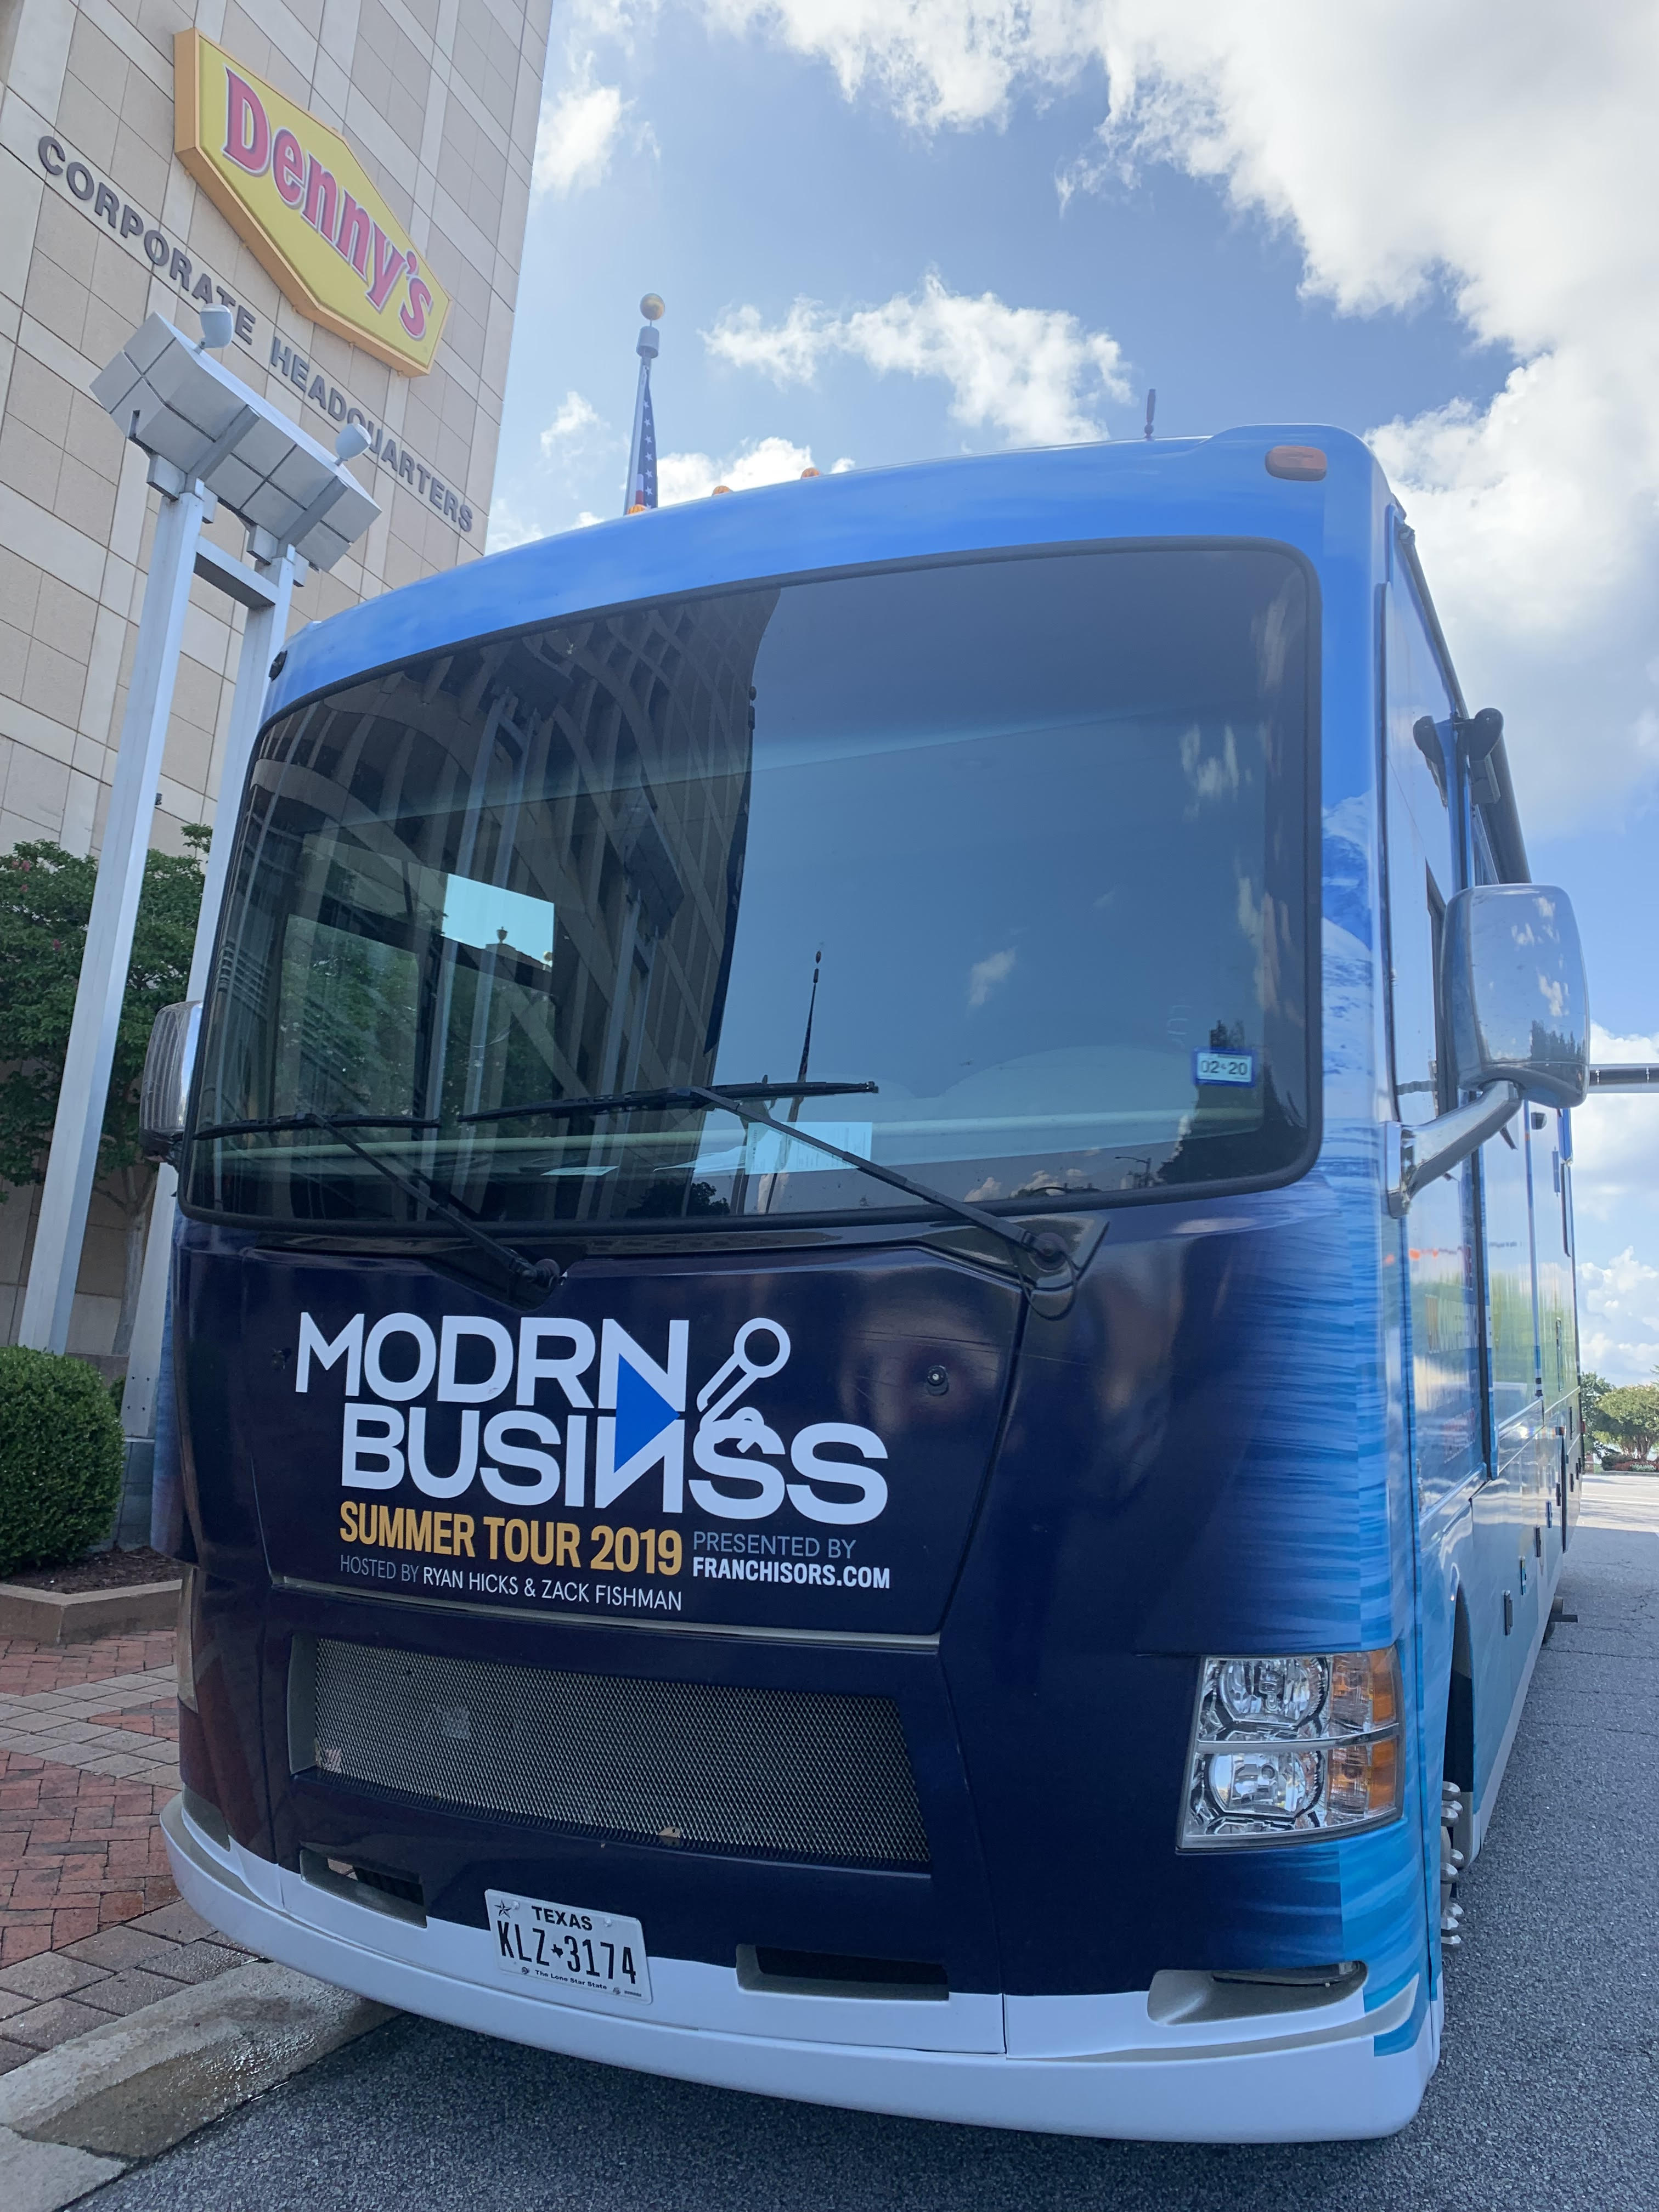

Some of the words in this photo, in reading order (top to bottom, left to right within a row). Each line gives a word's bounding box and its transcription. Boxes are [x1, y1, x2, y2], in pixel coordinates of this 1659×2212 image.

[223, 64, 434, 341] Denny's
[295, 1312, 688, 1412] MODRN
[340, 1501, 475, 1557] SUMMER
[483, 1516, 580, 1567] TOUR
[590, 1526, 682, 1576] 2019
[693, 1531, 820, 1557] PRESENTED
[828, 1539, 856, 1559] BY
[340, 1555, 396, 1579] HOSTED
[401, 1564, 419, 1583] BY
[424, 1566, 463, 1589] RYAN
[469, 1572, 518, 1595] HICKS
[524, 1580, 536, 1597] &
[541, 1579, 589, 1602] ZACK
[596, 1585, 681, 1611] FISHMAN
[693, 1557, 890, 1589] FRANCHISORS.COM
[532, 1905, 592, 1931] TEXAS
[535, 1970, 549, 1978] The
[551, 1973, 568, 1982] Lone
[588, 1981, 607, 1990] State
